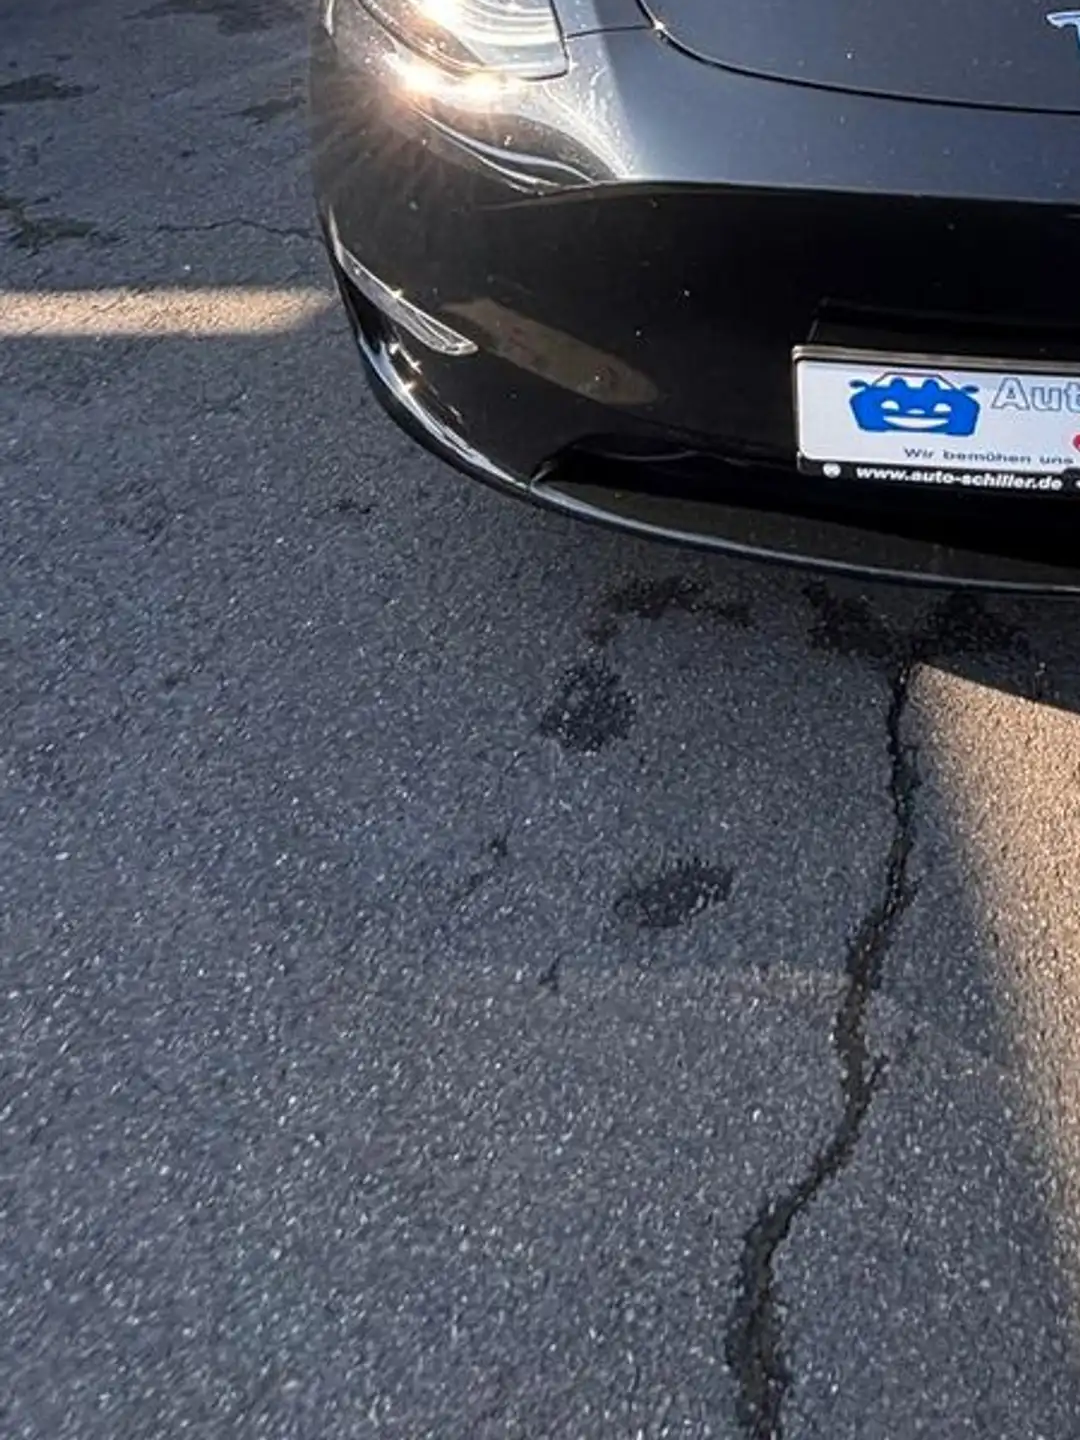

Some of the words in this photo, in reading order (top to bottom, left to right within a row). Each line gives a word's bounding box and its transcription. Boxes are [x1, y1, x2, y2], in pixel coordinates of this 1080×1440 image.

[903, 447, 934, 459] Wir
[1039, 454, 1074, 465] uns
[856, 465, 1064, 492] www.auto-schiller.de
